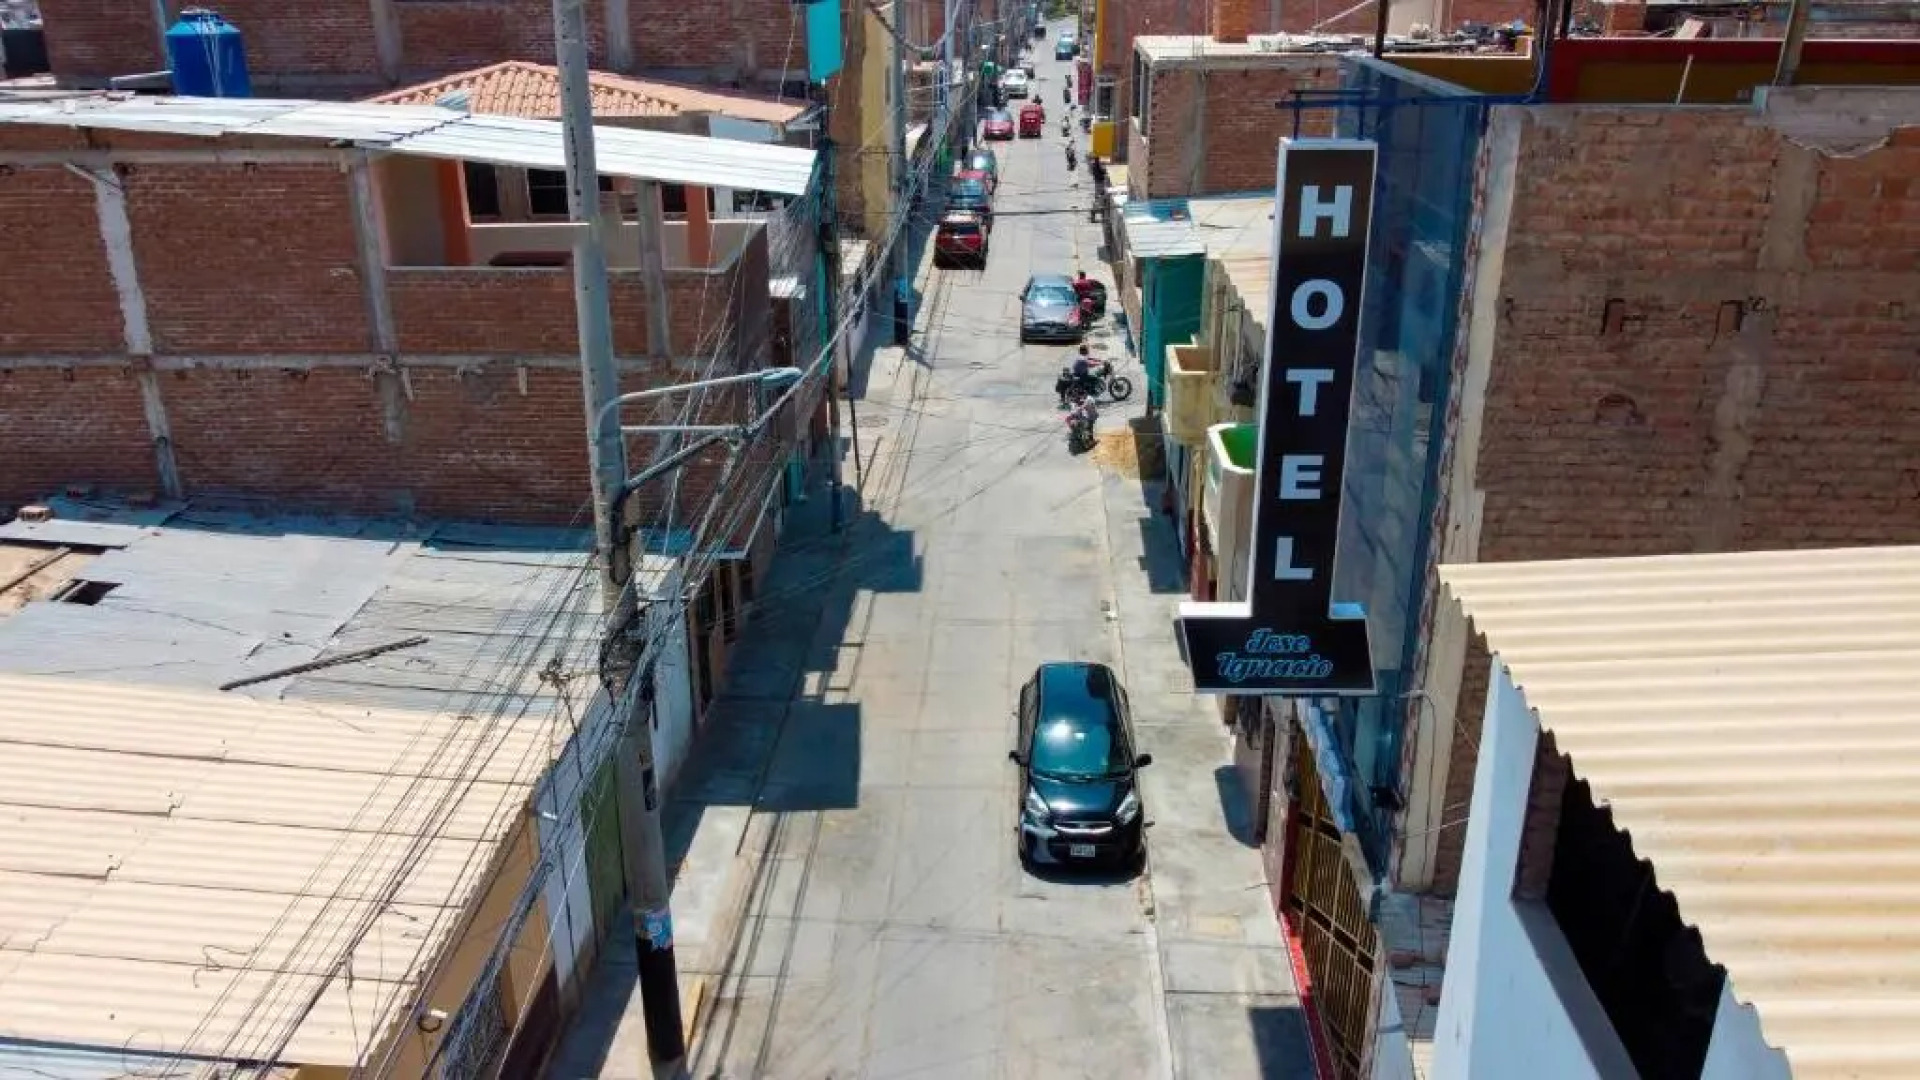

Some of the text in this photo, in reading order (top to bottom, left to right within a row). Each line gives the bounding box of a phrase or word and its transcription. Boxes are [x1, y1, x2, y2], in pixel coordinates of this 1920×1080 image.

[1274, 185, 1353, 580] HOTEL
[1246, 628, 1311, 652] Jose
[1216, 652, 1333, 682] Ignacio
